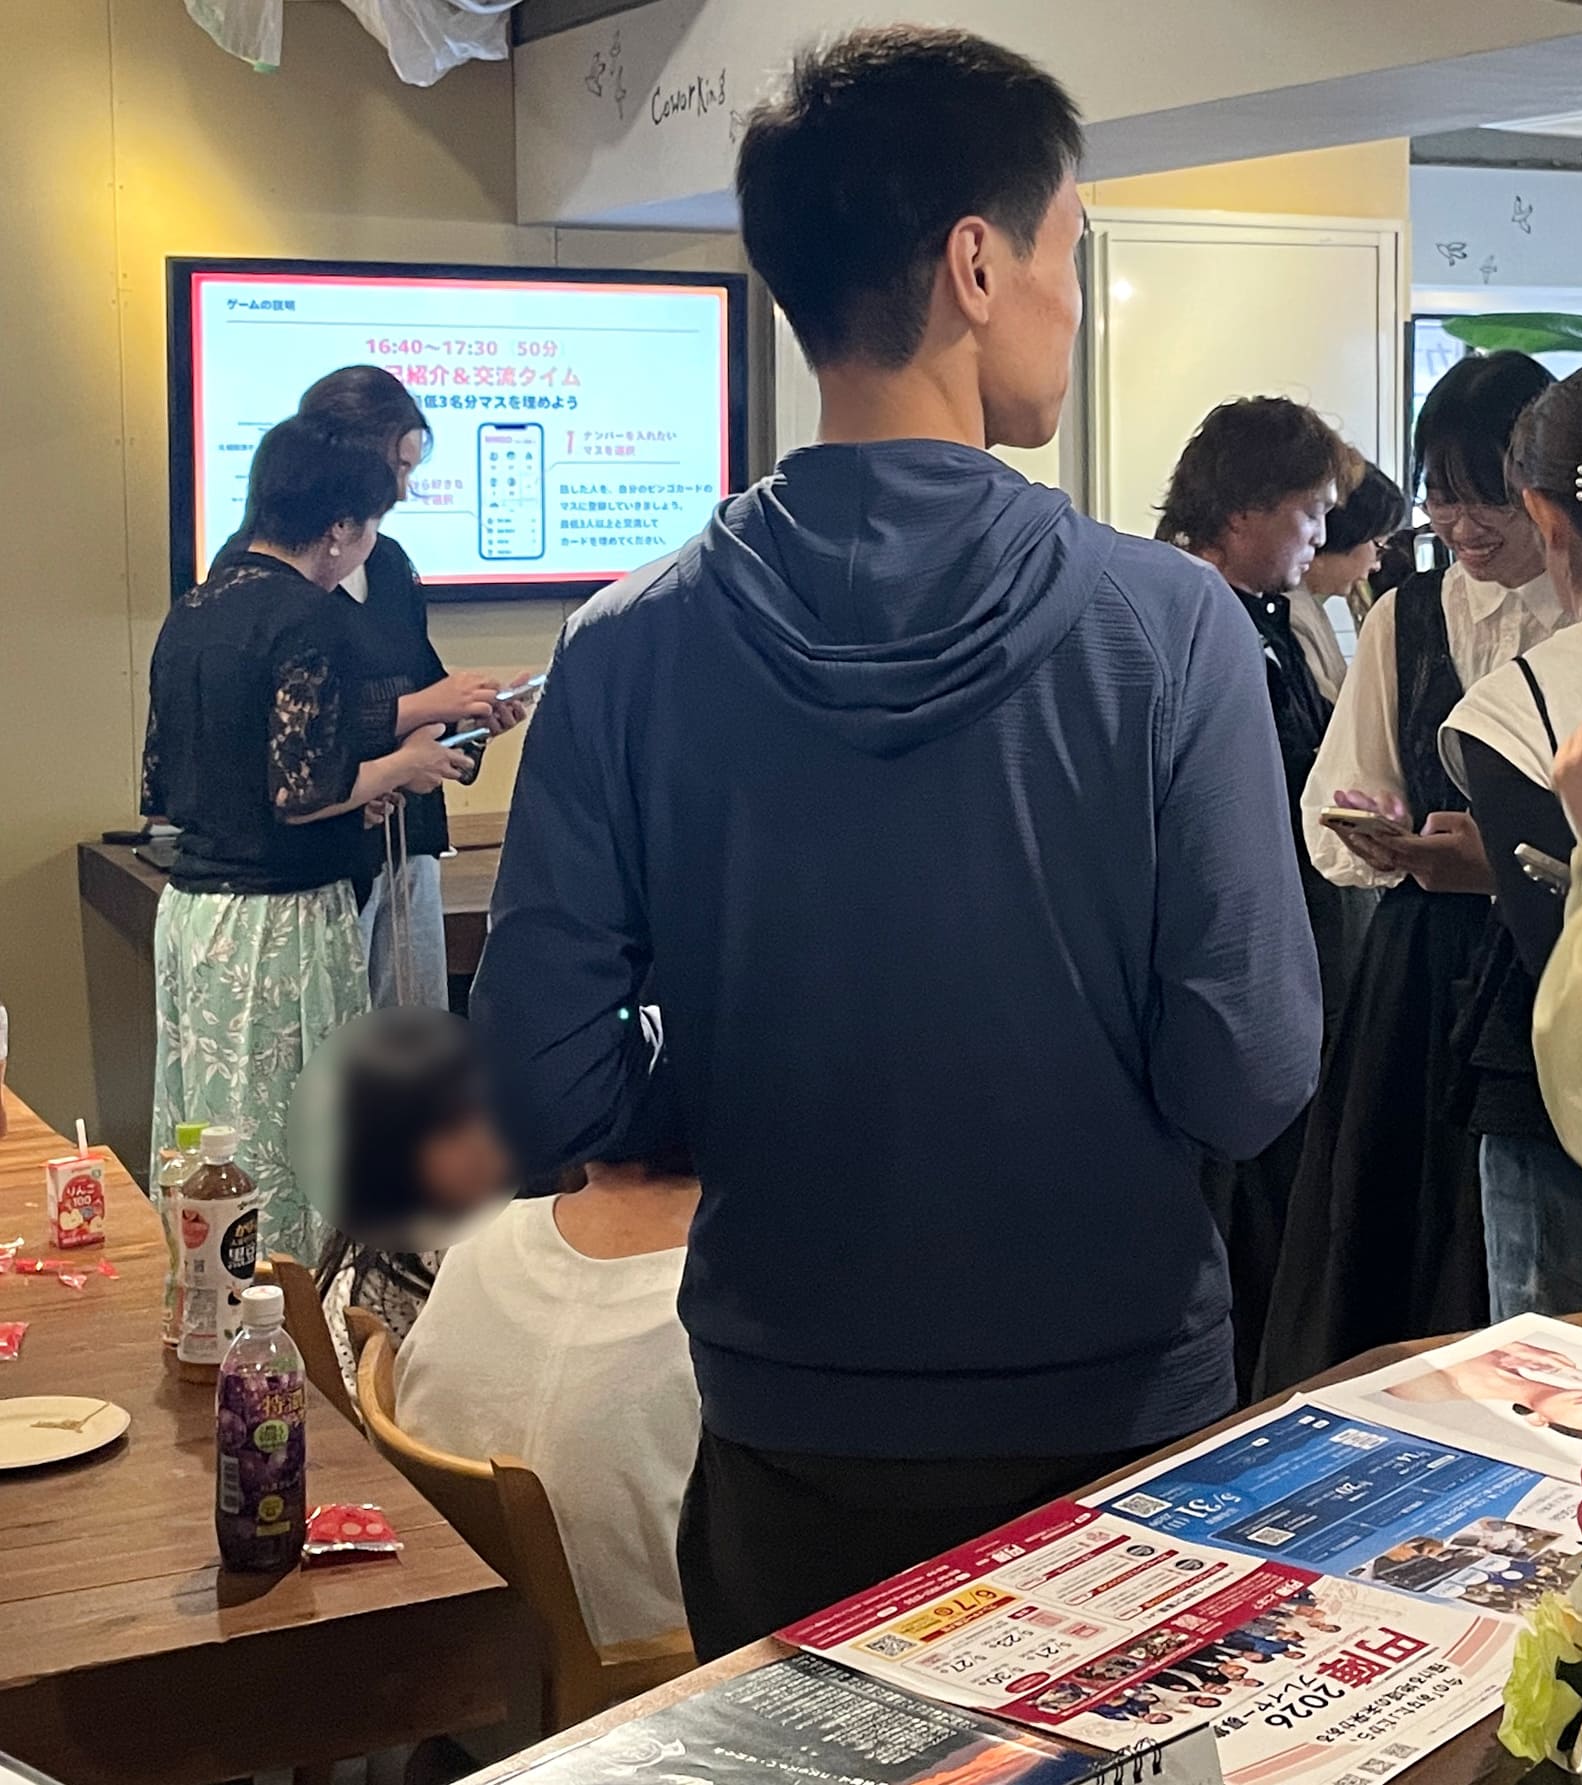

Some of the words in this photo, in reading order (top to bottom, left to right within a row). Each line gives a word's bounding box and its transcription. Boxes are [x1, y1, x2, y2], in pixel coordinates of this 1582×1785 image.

[227, 299, 296, 312] ゲームの説明
[516, 339, 559, 358] 50分
[1174, 1491, 1242, 1519] 5/31
[952, 1588, 997, 1611] 6/7
[1314, 1626, 1430, 1689] 円陣
[1264, 1682, 1346, 1728] 2026
